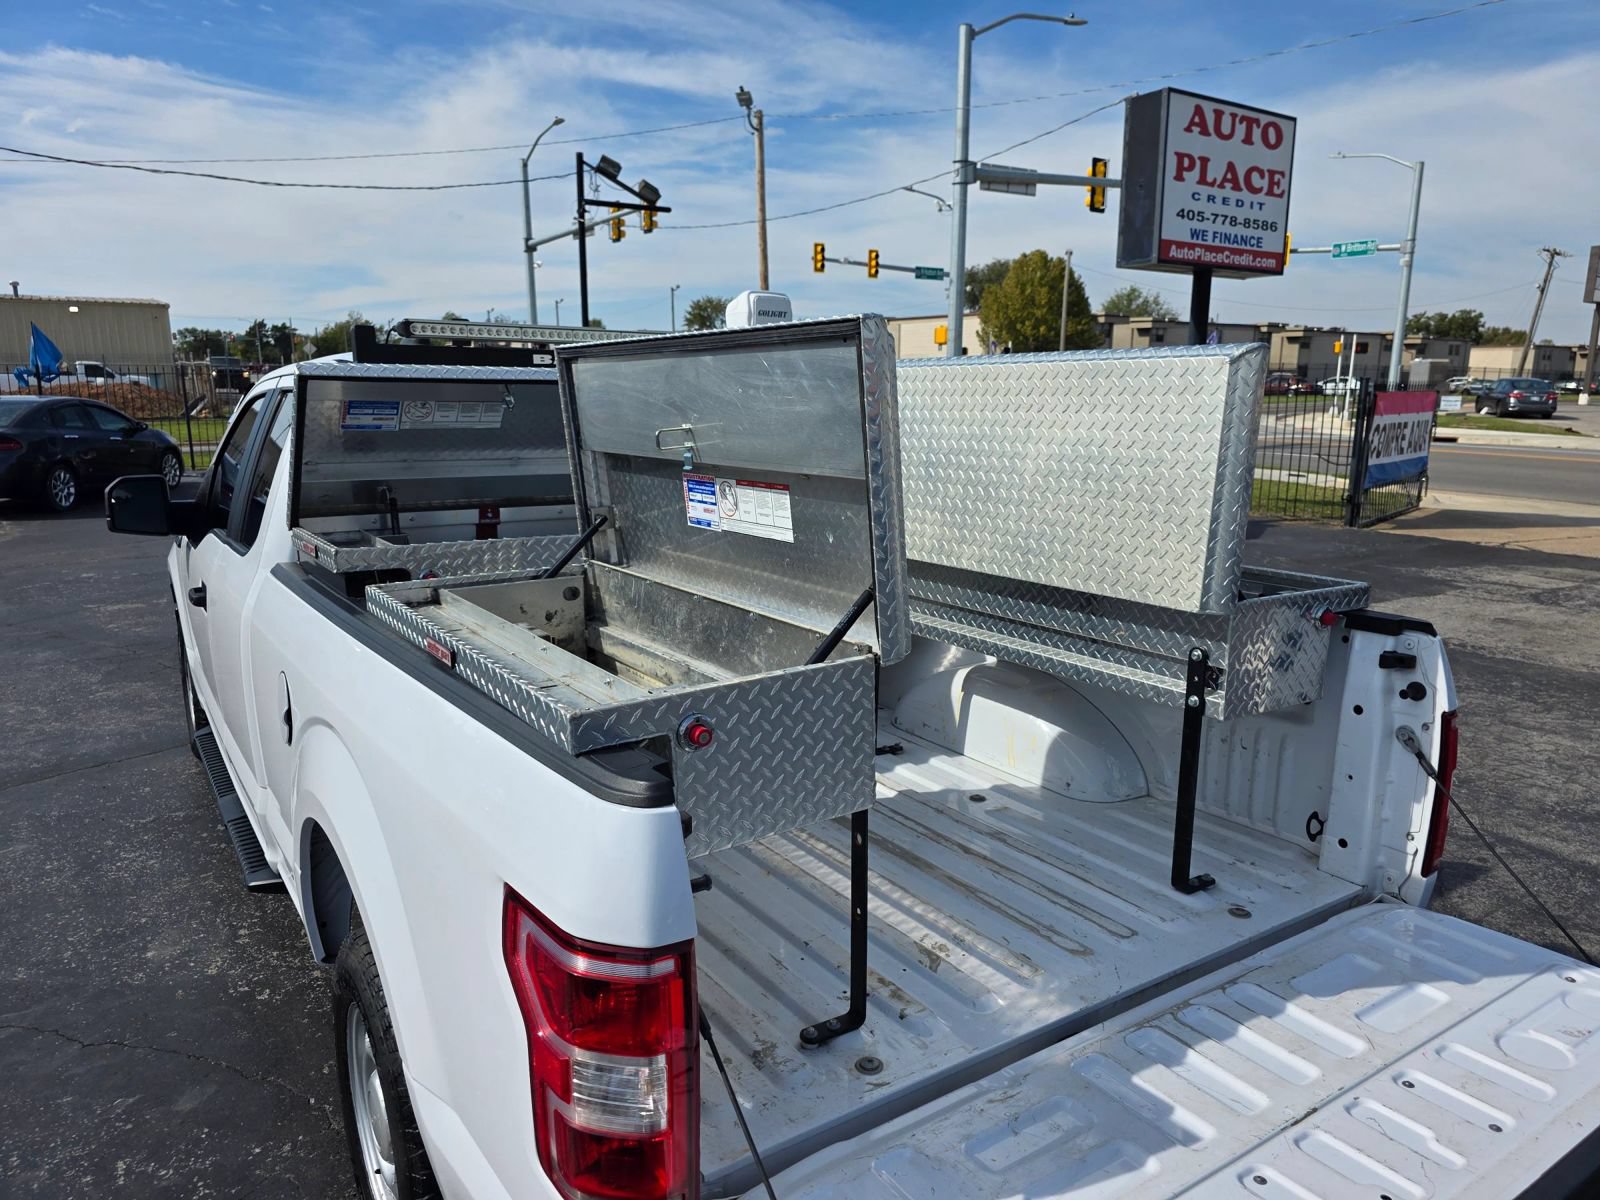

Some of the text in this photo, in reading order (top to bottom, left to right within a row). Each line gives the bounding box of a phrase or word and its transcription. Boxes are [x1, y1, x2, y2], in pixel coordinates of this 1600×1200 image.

[1183, 104, 1284, 150] AUTO
[1173, 151, 1286, 199] PLACE
[1191, 191, 1267, 211] CREDIT
[1176, 208, 1278, 232] 405-778-8586
[1189, 227, 1264, 249] WE FINANCE
[1169, 245, 1276, 268] AutoPlaceCredit.com
[757, 309, 788, 319] GOLIGHT
[1370, 422, 1409, 459] COMPRE
